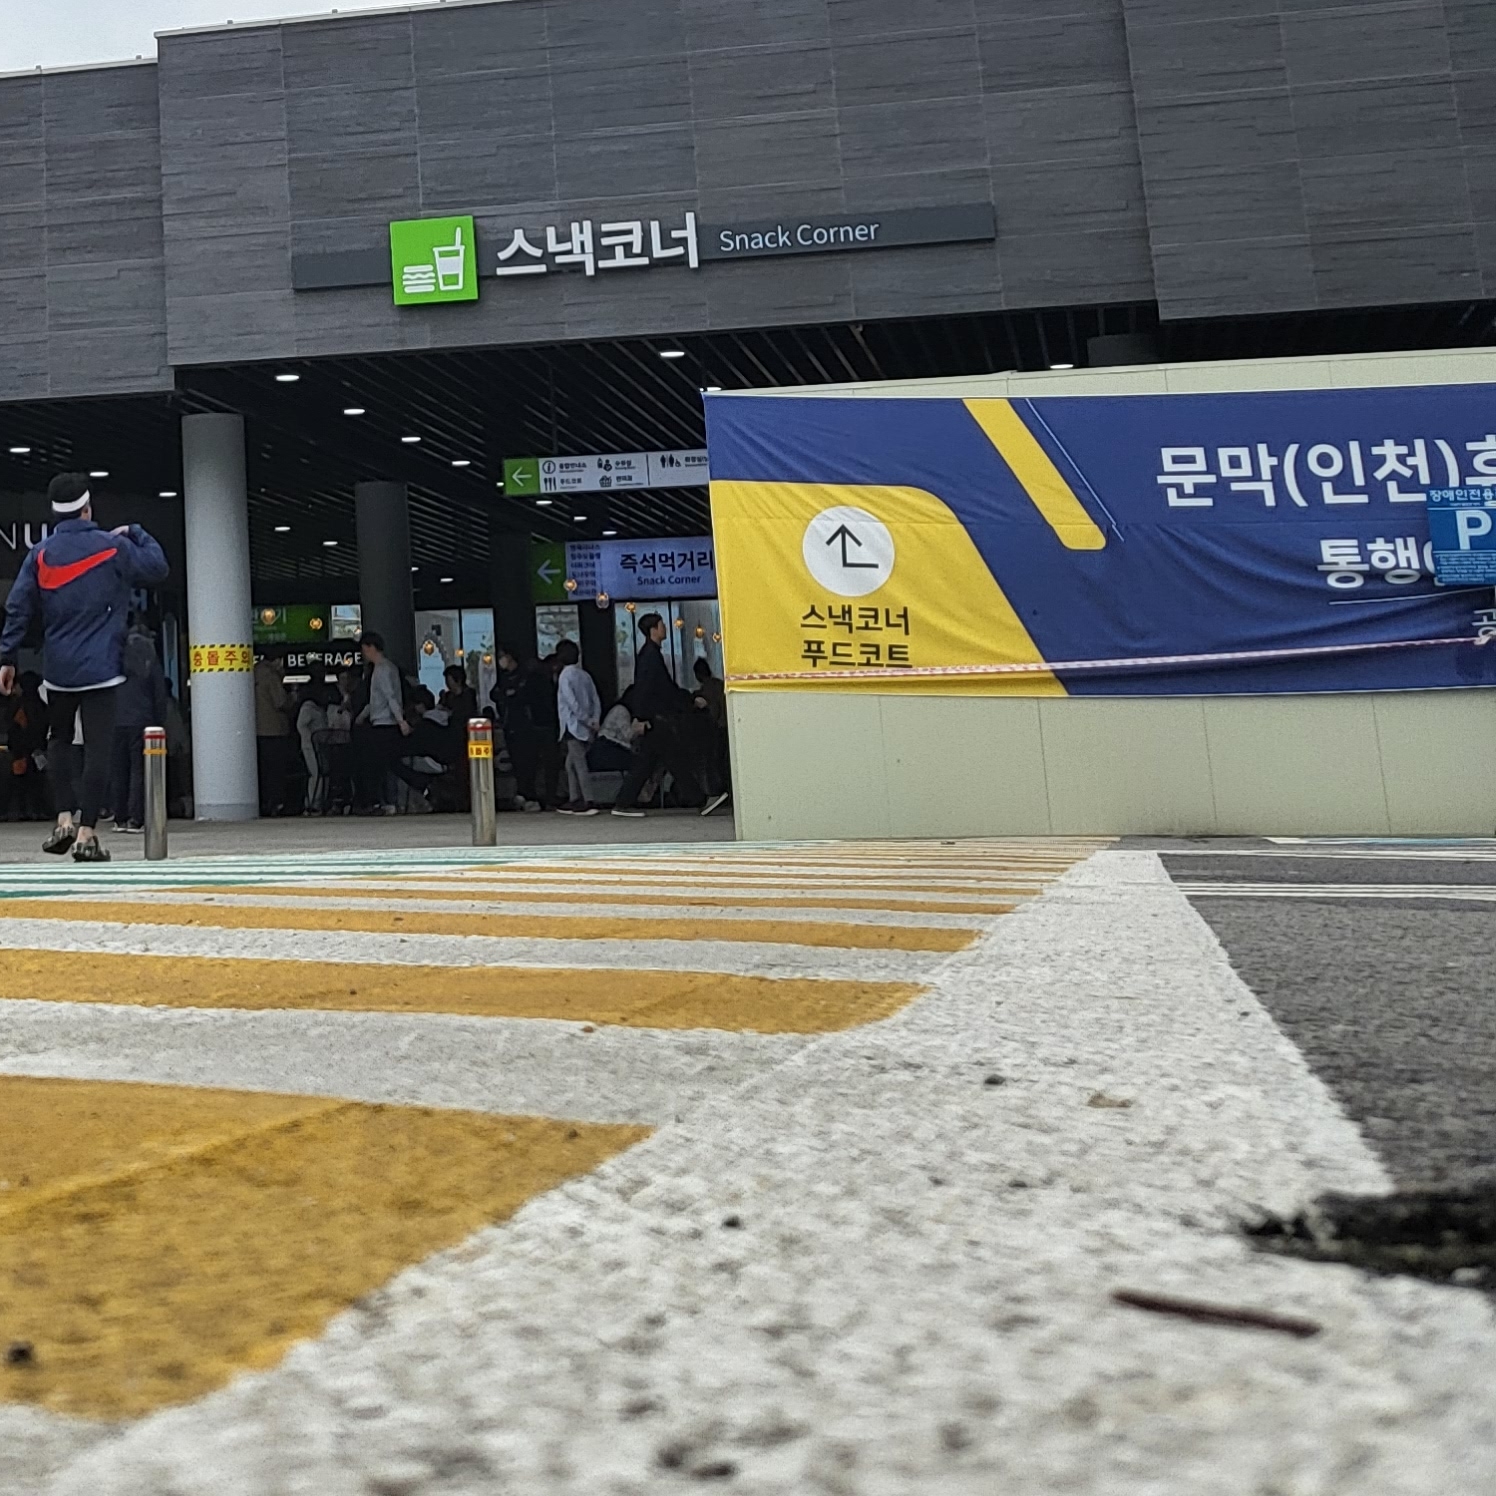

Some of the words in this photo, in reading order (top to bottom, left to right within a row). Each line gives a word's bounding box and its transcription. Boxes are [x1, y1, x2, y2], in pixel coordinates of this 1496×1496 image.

[496, 212, 699, 276] 스낵코너
[719, 225, 792, 252] Snack
[796, 223, 880, 246] Corner
[1429, 488, 1496, 503] 장애인전용
[1456, 509, 1492, 551] P
[620, 550, 714, 574] 즉석먹거리
[1317, 537, 1446, 588] 통행(
[637, 575, 666, 586] Snack
[668, 574, 702, 585] Corner
[800, 604, 909, 636] 스낵코너
[193, 651, 251, 667] 충돌주의
[801, 640, 913, 669] 푸드코트
